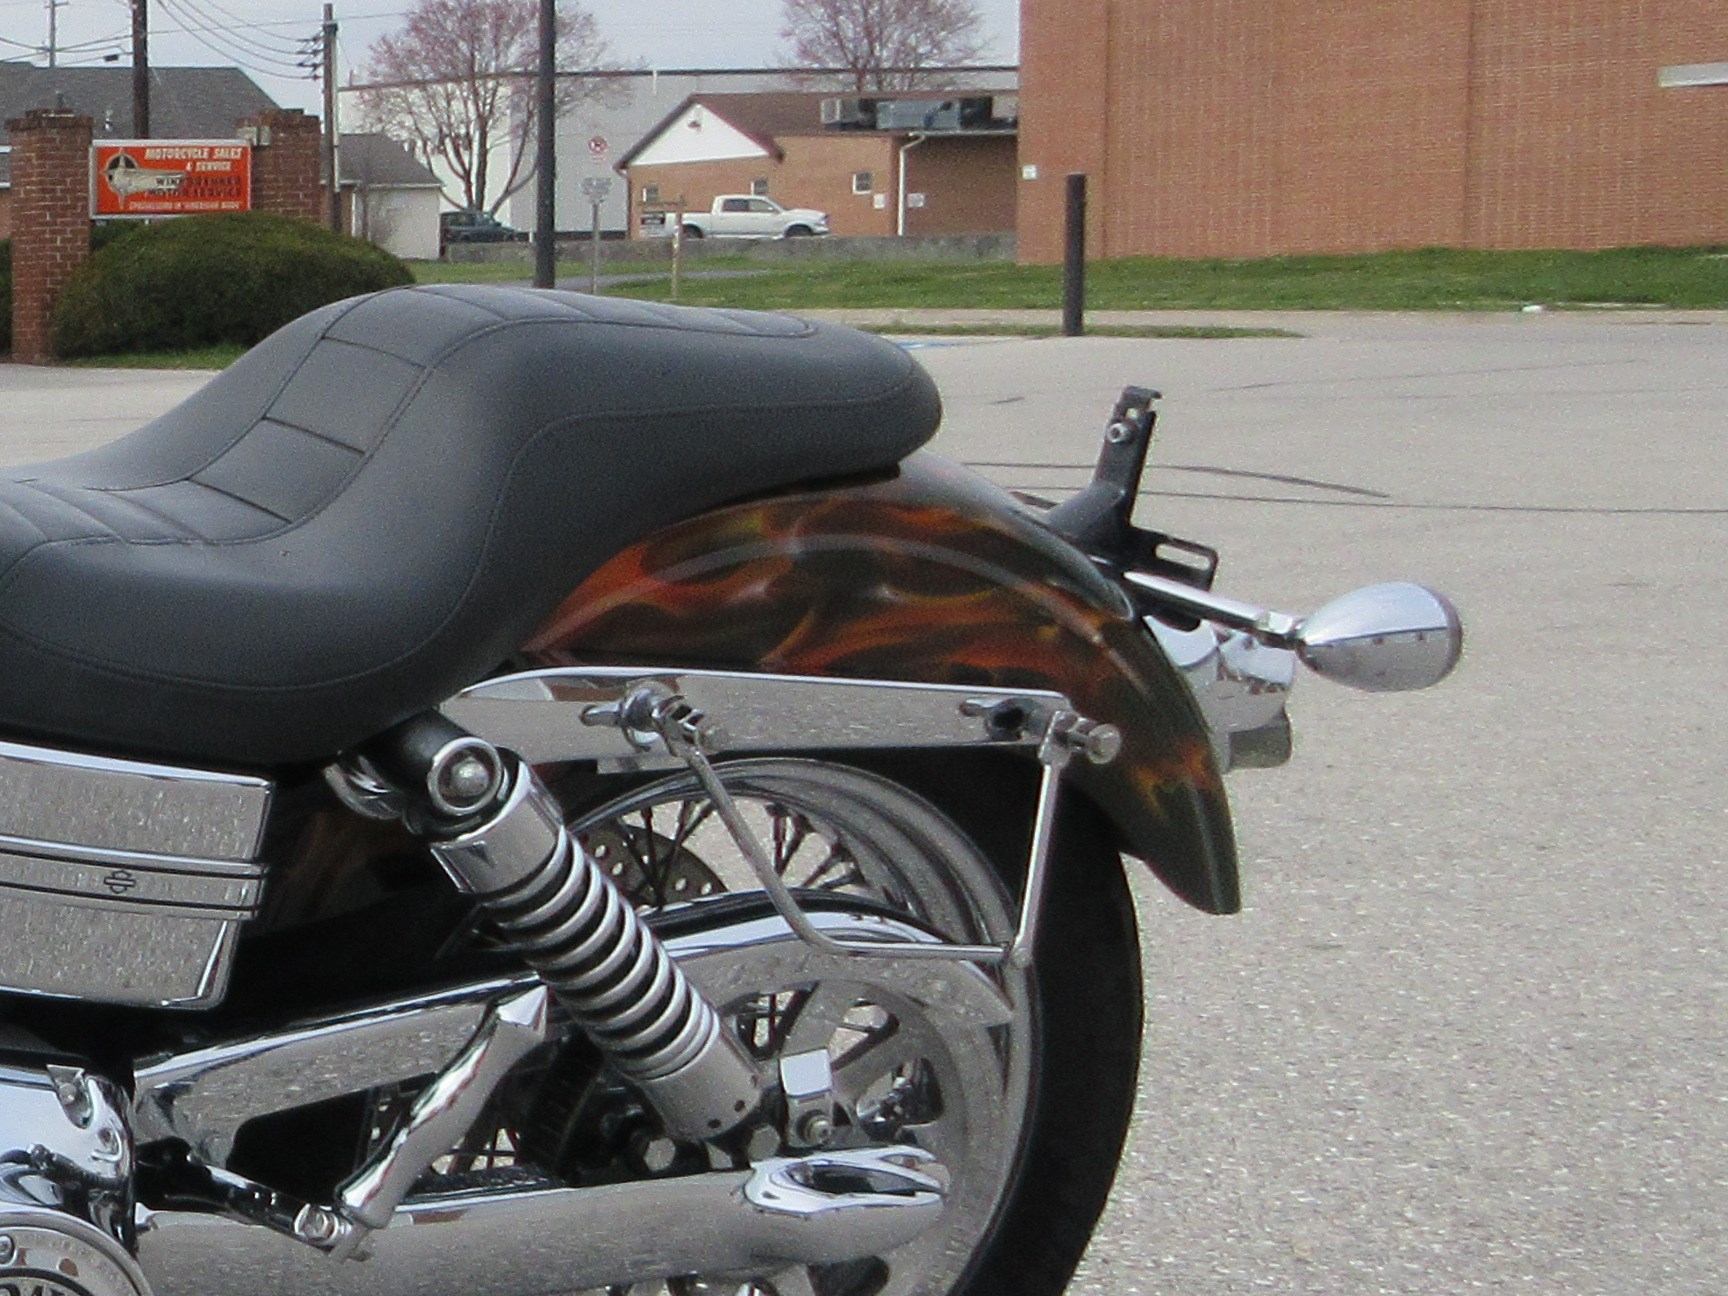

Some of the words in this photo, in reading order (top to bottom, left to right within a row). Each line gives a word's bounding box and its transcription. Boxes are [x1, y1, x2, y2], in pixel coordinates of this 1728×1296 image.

[144, 147, 209, 160] MOTORCYCLE
[212, 147, 242, 159] SALES
[195, 161, 231, 172] SERVICE
